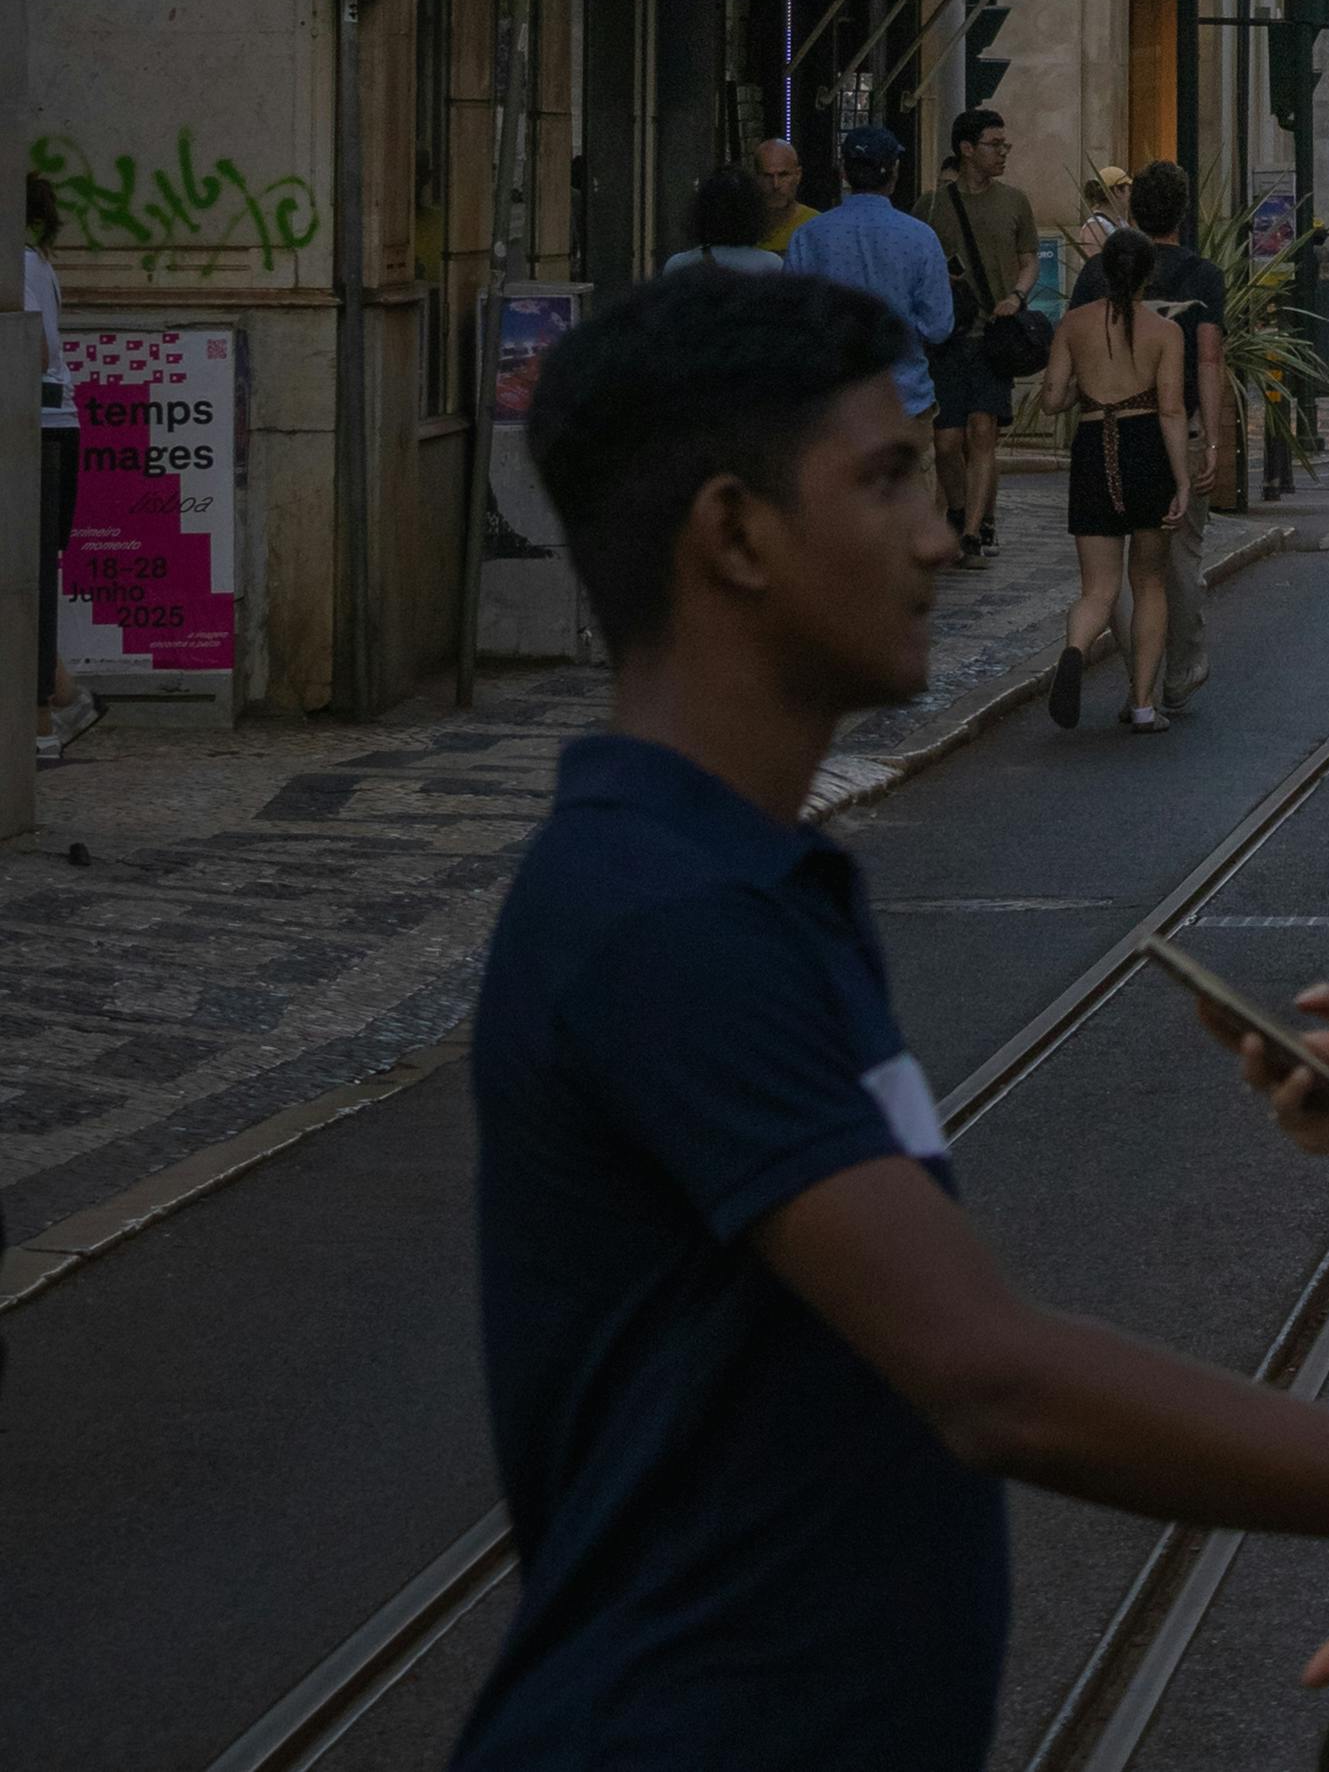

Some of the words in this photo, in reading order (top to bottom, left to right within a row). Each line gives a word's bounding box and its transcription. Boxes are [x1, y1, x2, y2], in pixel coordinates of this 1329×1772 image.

[88, 398, 214, 434] temps
[82, 444, 215, 478] mages
[80, 539, 142, 552] momento
[68, 582, 146, 604] Junho
[116, 606, 186, 629] 2025
